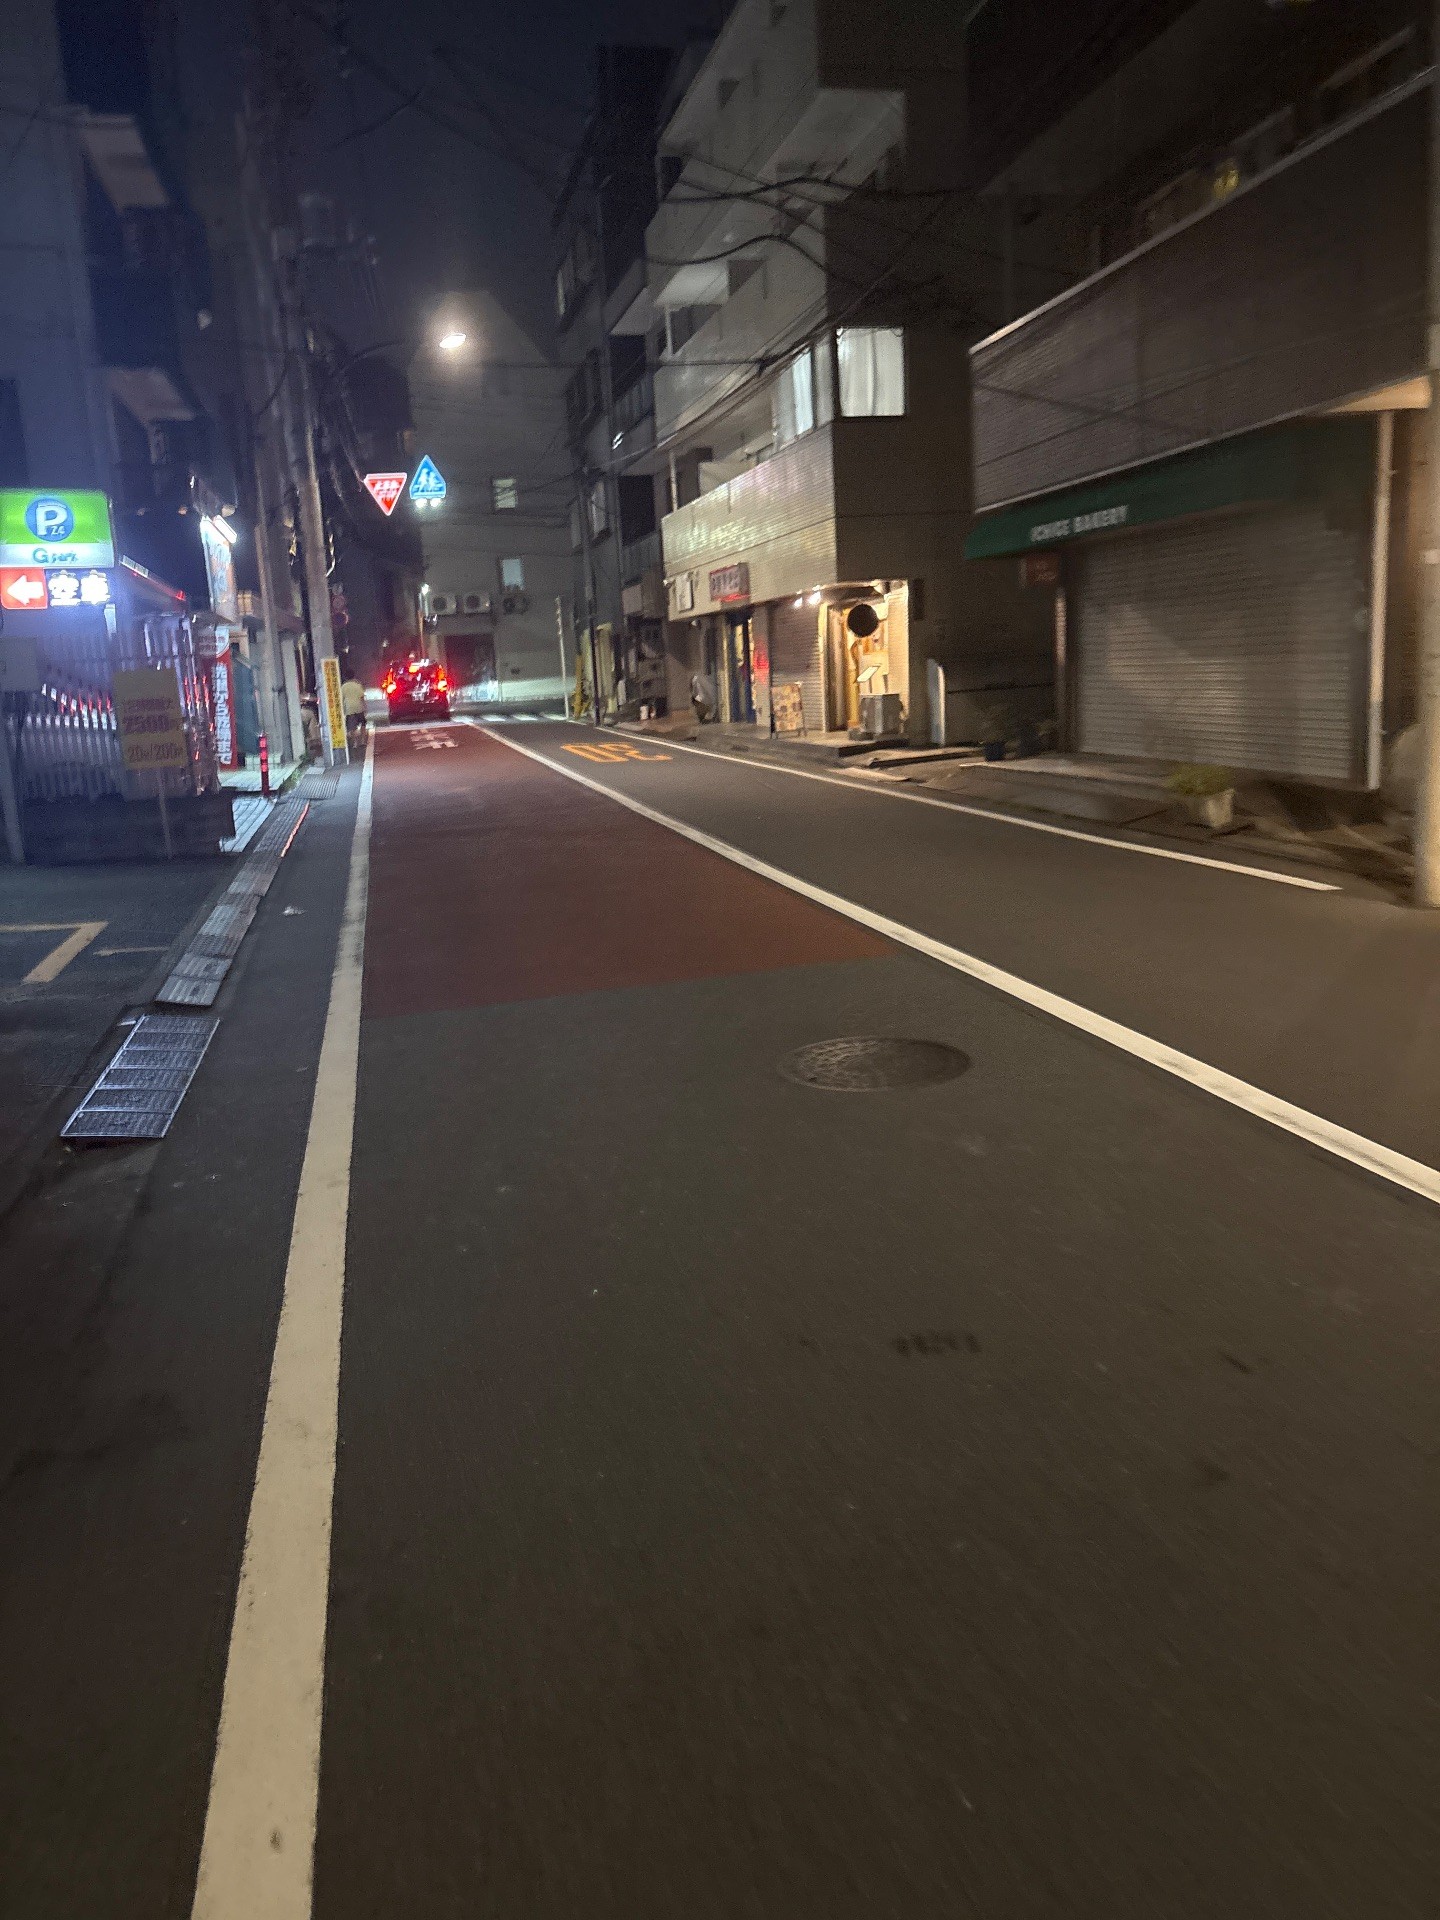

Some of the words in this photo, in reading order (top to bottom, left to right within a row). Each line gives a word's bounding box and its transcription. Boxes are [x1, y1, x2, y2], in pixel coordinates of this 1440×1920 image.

[374, 480, 400, 490] 止まれ
[36, 502, 67, 536] P
[48, 570, 110, 606] 空車
[559, 742, 674, 764] 30
